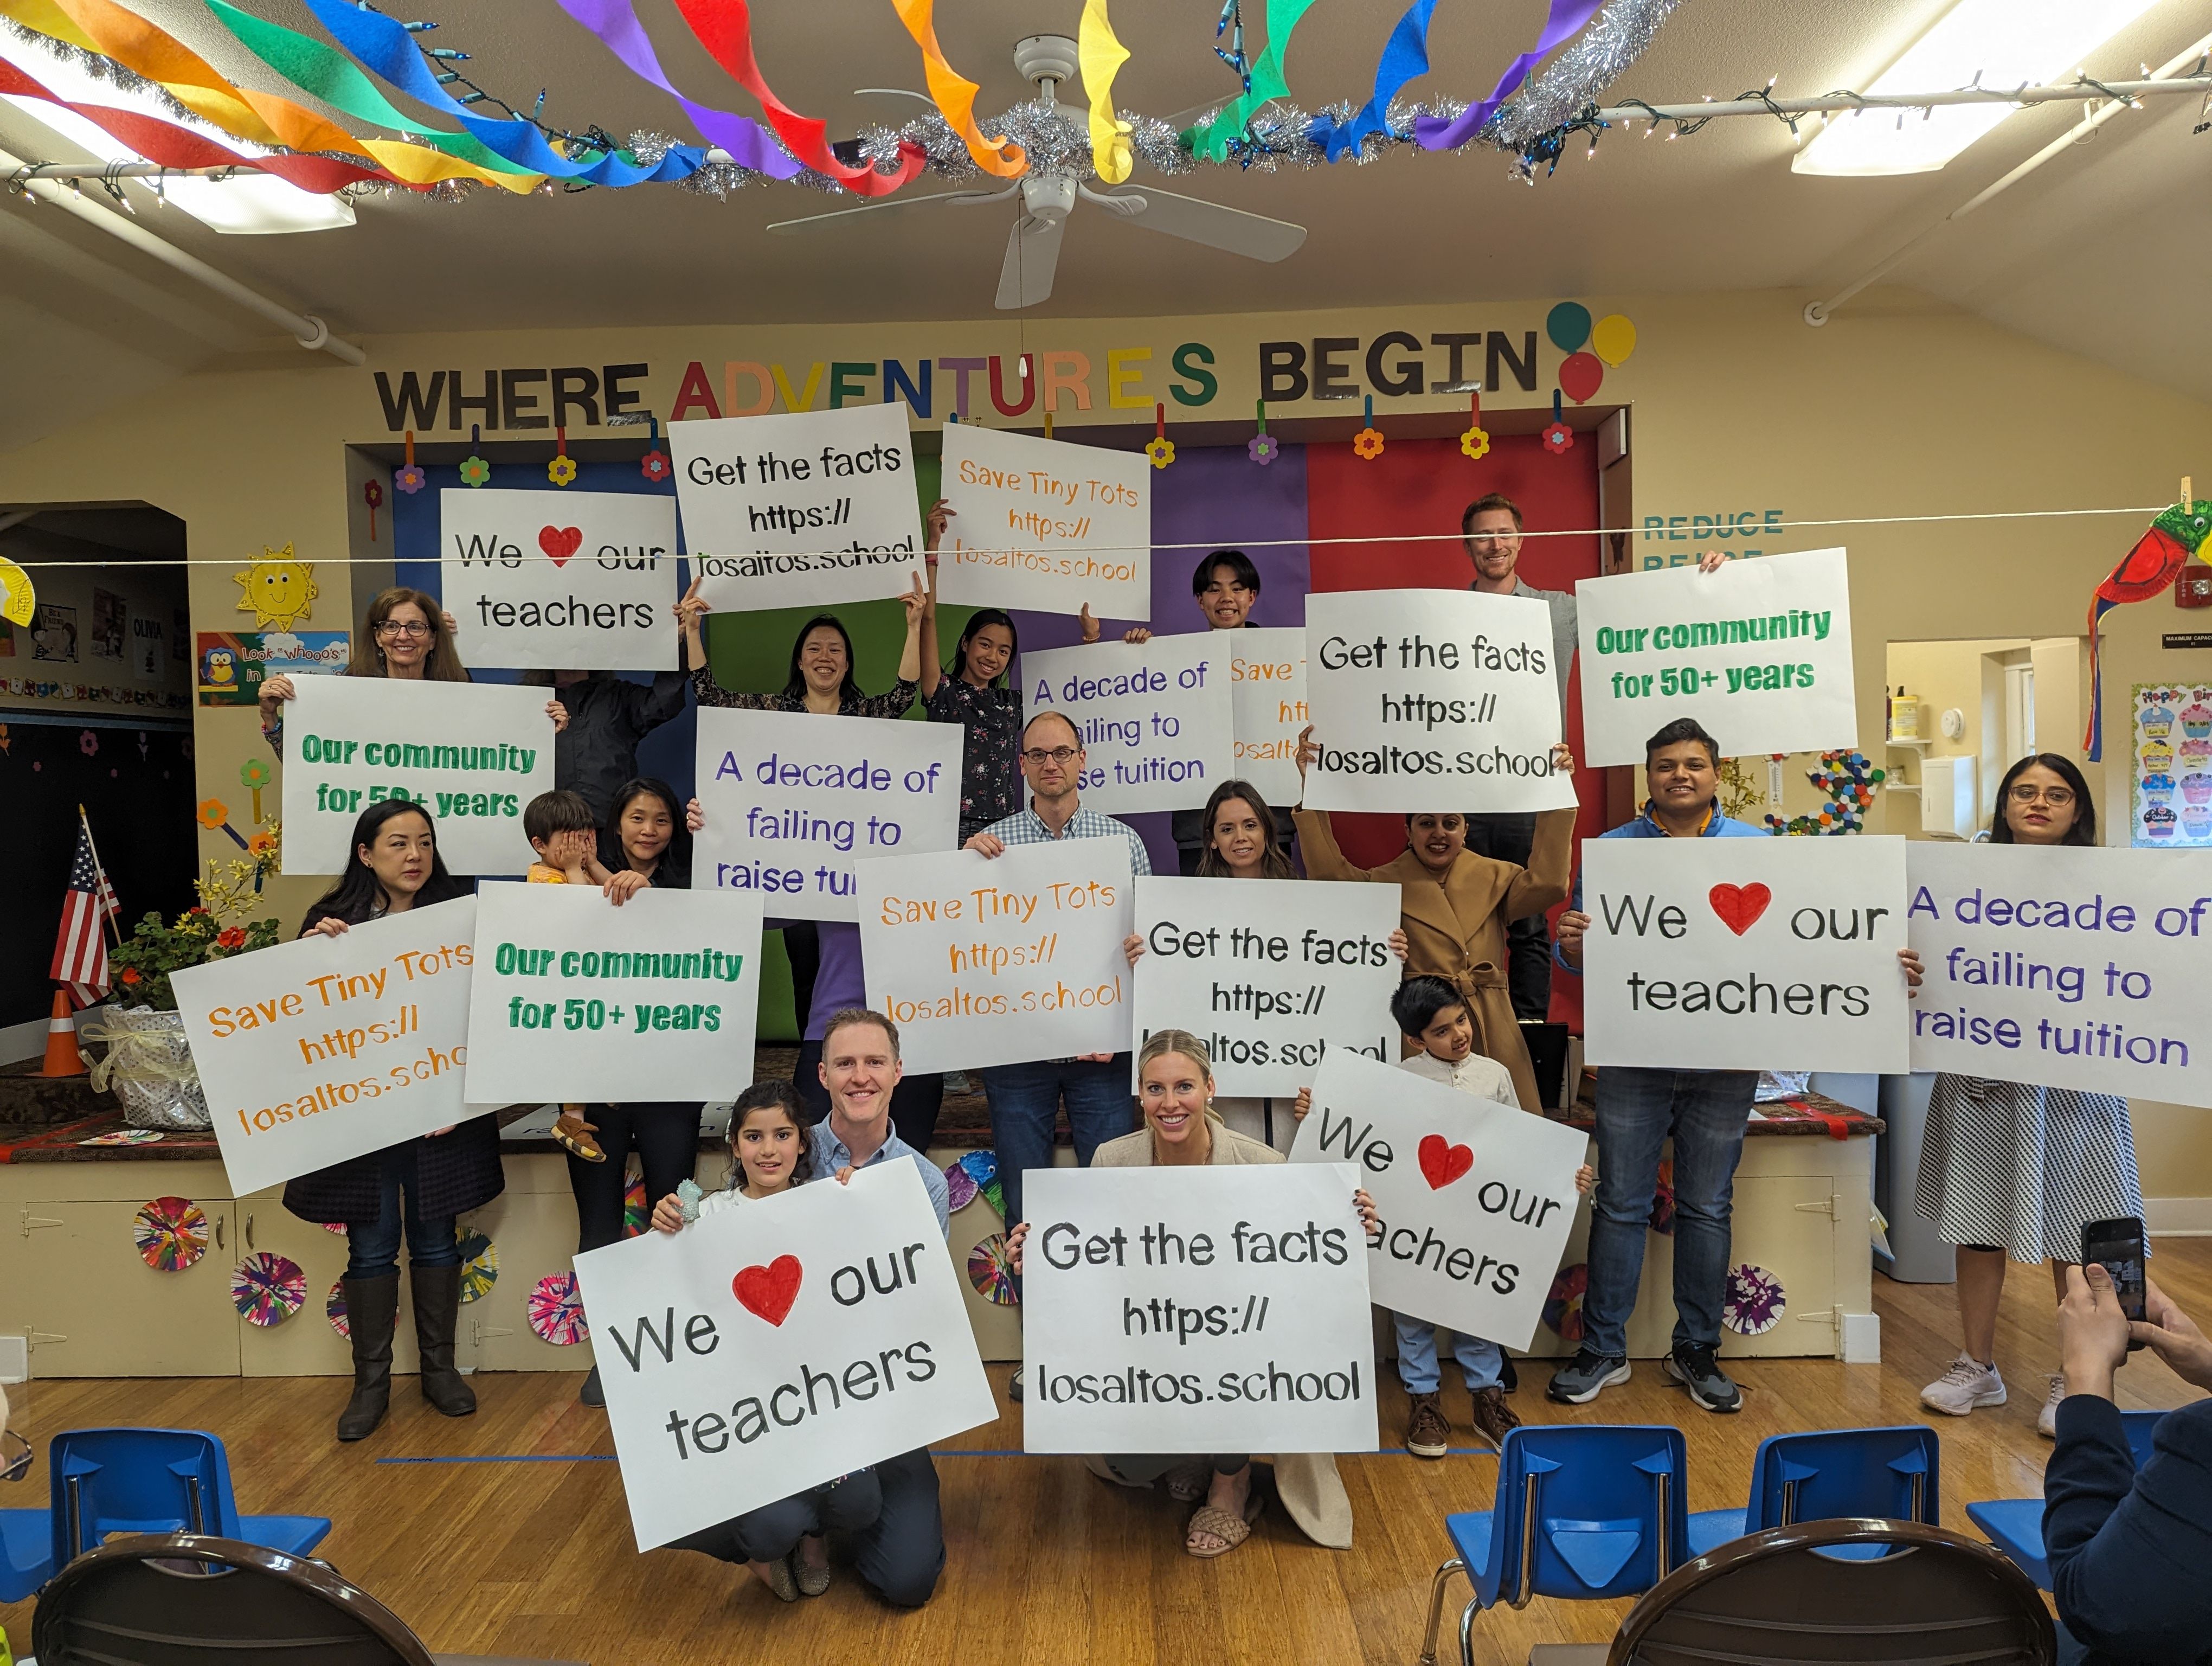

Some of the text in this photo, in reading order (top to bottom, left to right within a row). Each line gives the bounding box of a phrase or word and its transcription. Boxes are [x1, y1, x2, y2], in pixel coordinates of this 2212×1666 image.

[374, 331, 1537, 431] WHERE ADVENTURES BEGIN
[688, 444, 901, 485] Get the facts
[960, 460, 1137, 507] Save Tiny Tots
[748, 498, 851, 534] https://
[1009, 509, 1090, 542] https://
[1644, 510, 1783, 540] REDUCE
[454, 534, 666, 571] We our
[698, 535, 915, 577] losaltos.school
[956, 539, 1136, 582] losaltos.school
[477, 594, 653, 629] teachers
[1597, 610, 1830, 654] Our community
[242, 648, 274, 662] Look
[247, 669, 261, 682] in
[1320, 635, 1546, 675] Get the facts
[1034, 662, 1208, 705] A decade of
[1611, 664, 1814, 699] for 50+ years
[2142, 690, 2187, 704] Happy
[1076, 712, 1179, 747] ailing to
[1382, 693, 1496, 731] https://
[303, 735, 536, 774] Our community
[715, 751, 941, 793] A decade of
[1114, 757, 1204, 784] tuition
[1317, 743, 1555, 777] losaltos.school
[317, 783, 362, 813] for
[436, 793, 519, 818] years
[747, 807, 901, 851] failing to
[718, 860, 803, 893] raise
[881, 881, 1115, 925] Save Tiny Tots
[1600, 894, 1888, 940] We our
[1908, 886, 2212, 937] A decade of
[496, 943, 743, 982] Our community
[950, 933, 1057, 976] https://
[1149, 921, 1387, 966] Get the facts
[209, 945, 473, 1037] Save Tiny Tots
[1627, 972, 1869, 1016] teachers
[1946, 947, 2151, 1002] failing to
[509, 996, 721, 1033] for 50+ years
[886, 975, 1122, 1022] losaltos.school
[1212, 982, 1326, 1020] https://
[1915, 1007, 2188, 1067] raise tuition
[237, 1047, 468, 1136] losaltos.scho
[1320, 1107, 1561, 1228] We our
[1042, 1221, 1348, 1270] Get the facts
[1367, 1218, 1519, 1295] achers
[608, 1243, 924, 1373] We our
[1124, 1295, 1269, 1345] https://
[665, 1341, 936, 1460] teachers
[1039, 1361, 1360, 1404] losaltos.school
